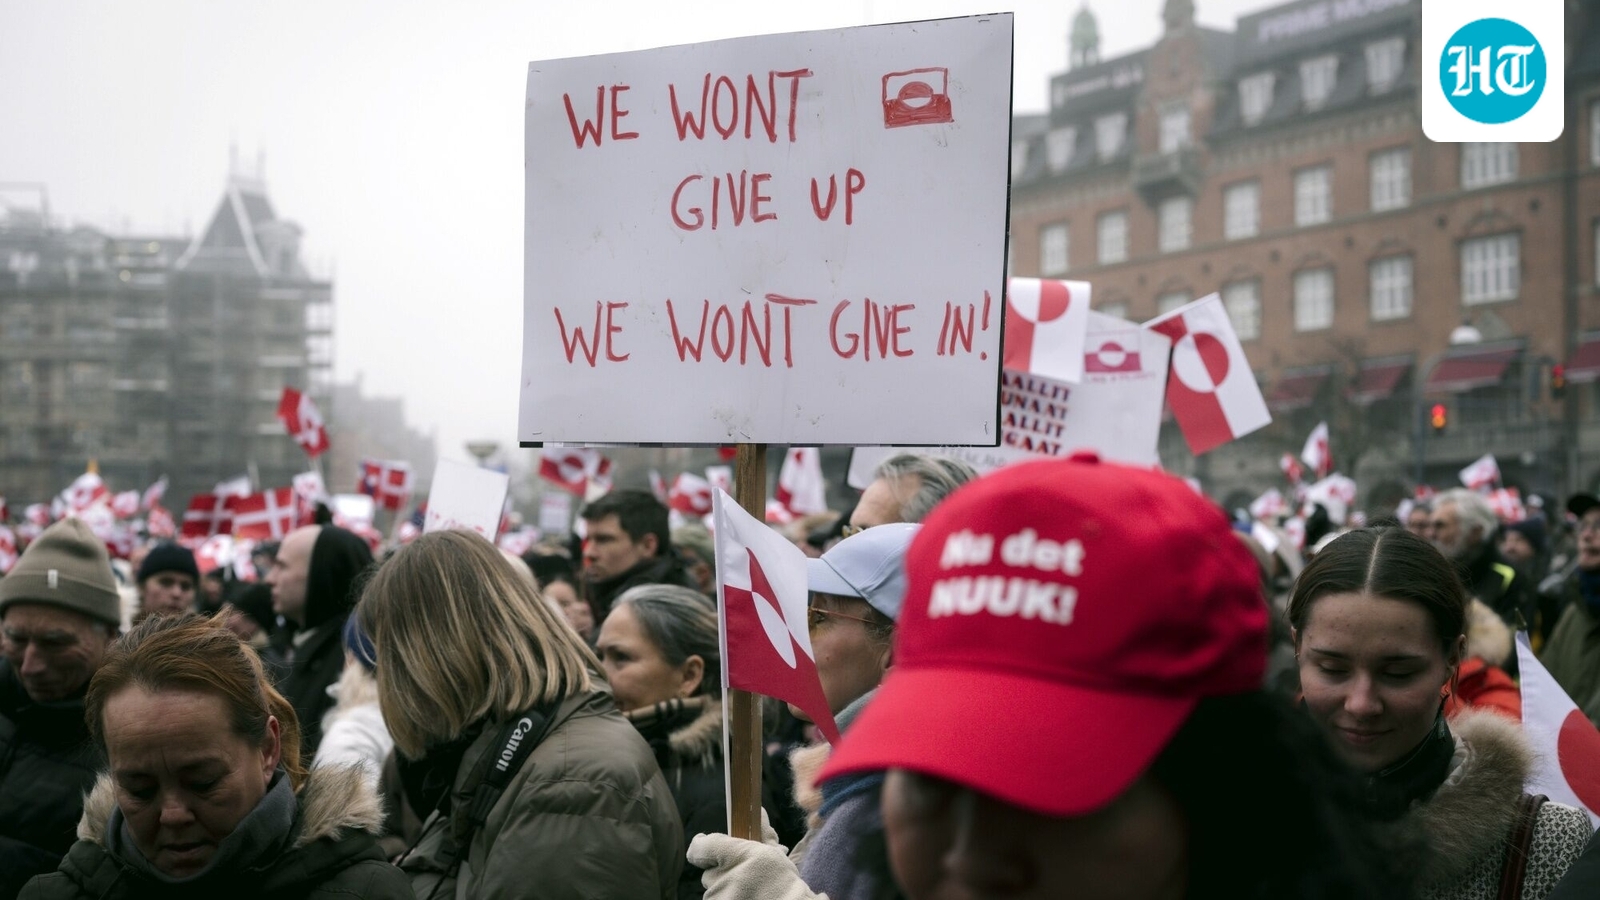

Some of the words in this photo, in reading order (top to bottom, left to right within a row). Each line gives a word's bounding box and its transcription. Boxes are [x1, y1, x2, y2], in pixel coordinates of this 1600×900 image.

[563, 84, 639, 149] WE
[669, 68, 813, 143] WONT
[671, 171, 777, 231] GIVE
[810, 168, 866, 226] UP
[554, 301, 629, 367] WE
[666, 293, 817, 368] WONT
[829, 298, 915, 361] GIVE
[937, 290, 991, 361] IN!
[1000, 527, 1086, 577] det
[927, 575, 1078, 626] NUUK!
[496, 717, 533, 772] Canon
